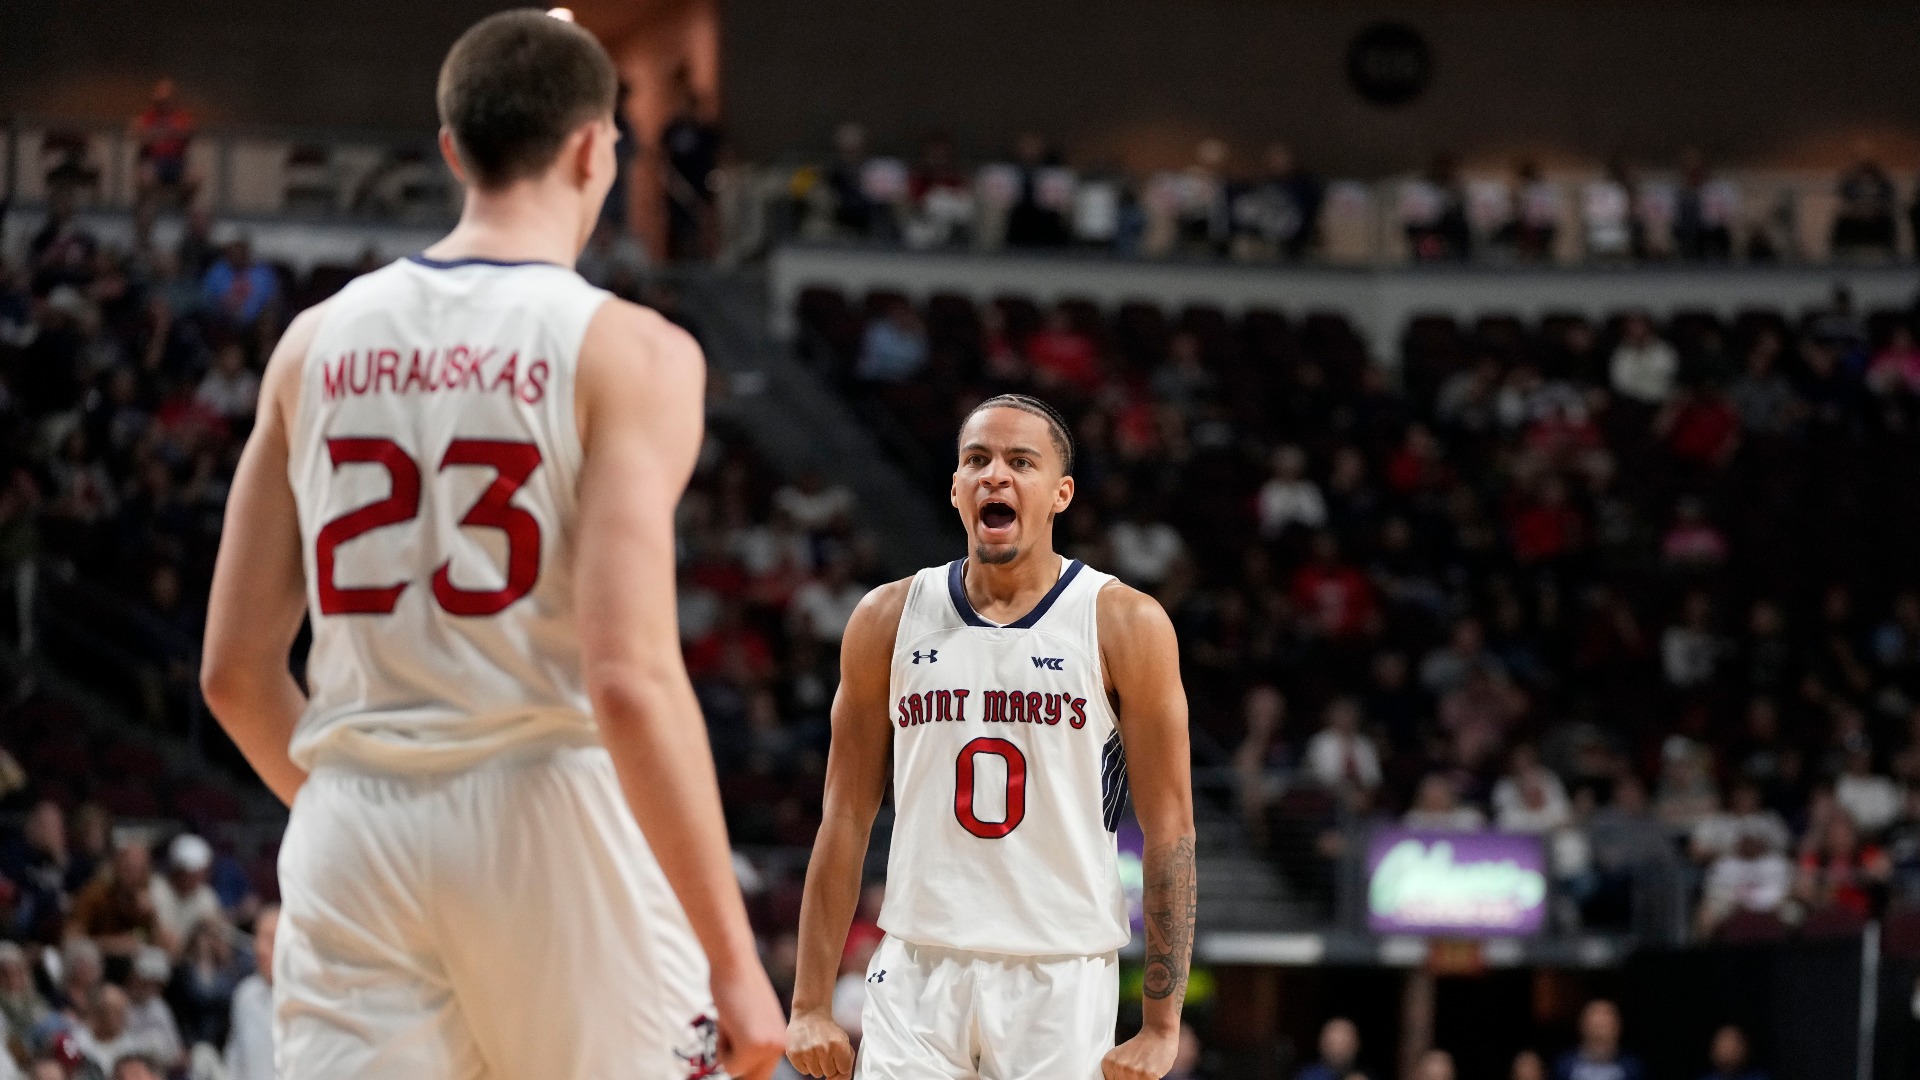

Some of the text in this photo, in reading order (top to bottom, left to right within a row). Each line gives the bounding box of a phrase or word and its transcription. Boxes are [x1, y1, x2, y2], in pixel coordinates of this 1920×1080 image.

[324, 345, 550, 405] MURAUSKAS
[316, 436, 543, 617] 23
[1031, 656, 1065, 671] WCC
[898, 688, 1087, 730] SAINT MARY'S
[954, 736, 1027, 840] 0
